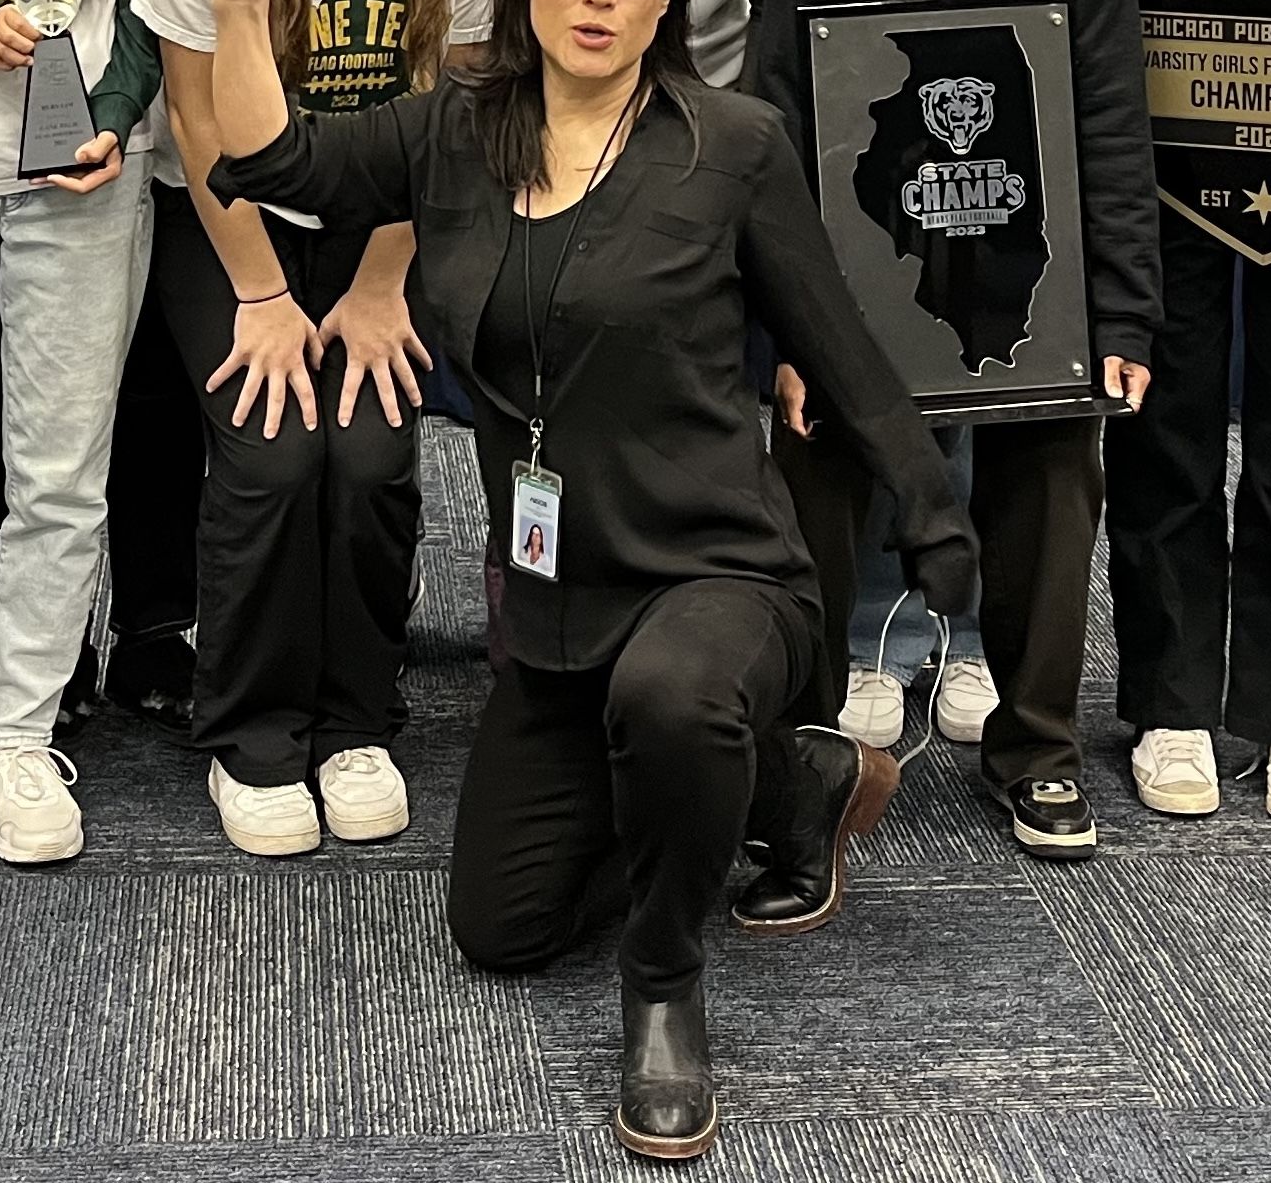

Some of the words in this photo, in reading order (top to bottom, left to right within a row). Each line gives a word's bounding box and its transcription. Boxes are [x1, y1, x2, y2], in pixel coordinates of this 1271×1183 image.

[309, 0, 351, 52] NE
[365, 0, 410, 52] TE
[1141, 16, 1224, 41] CHICAGO
[307, 55, 337, 72] FLAG
[339, 52, 395, 71] FOOTBALL
[1212, 54, 1259, 76] GIRLS
[922, 163, 1003, 182] STATE
[905, 177, 1022, 213] CHAMPS
[1201, 189, 1231, 208] EST
[945, 225, 986, 238] 2023
